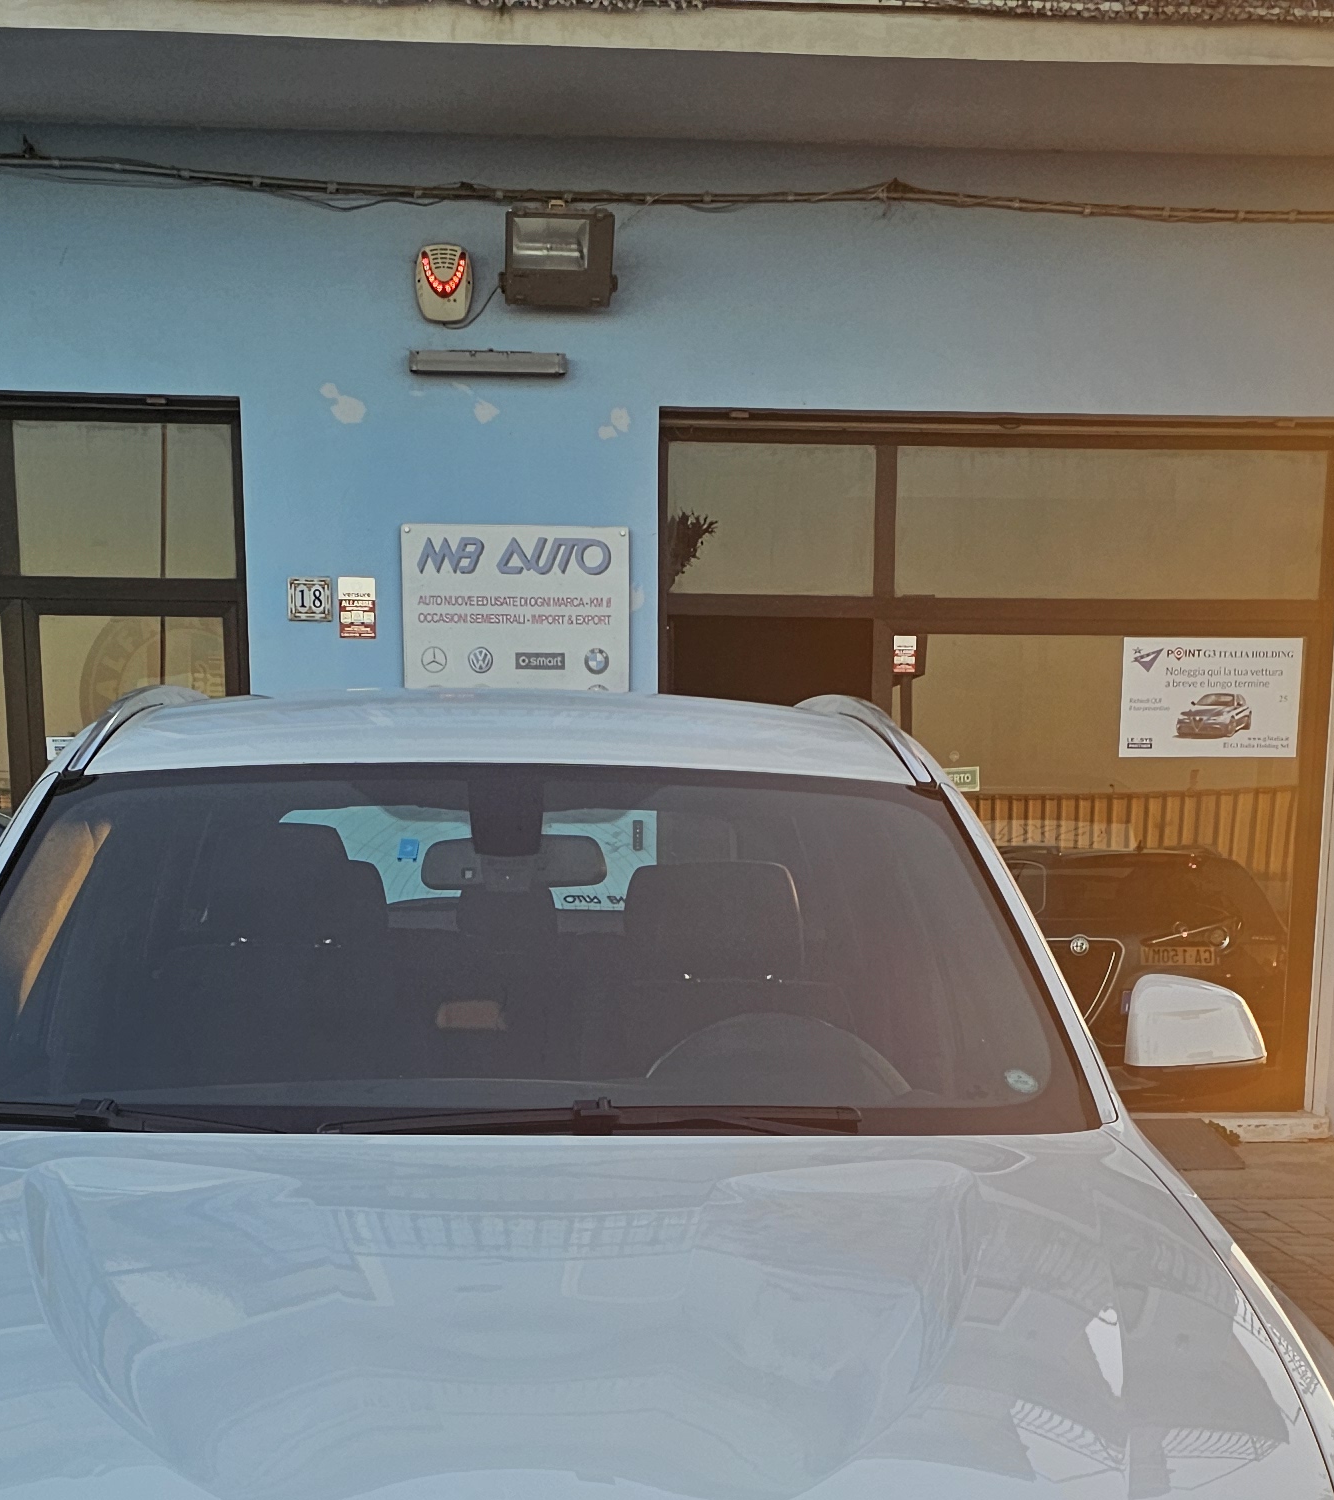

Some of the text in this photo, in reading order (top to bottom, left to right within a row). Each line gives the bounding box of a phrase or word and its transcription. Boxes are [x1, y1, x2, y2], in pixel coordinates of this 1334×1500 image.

[417, 537, 612, 576] MB AUTO
[299, 588, 323, 609] 18
[417, 595, 443, 606] AUTO
[444, 595, 475, 606] NUOVE
[476, 595, 488, 607] ED
[490, 596, 518, 607] USATE
[520, 596, 528, 607] DI
[529, 596, 551, 607] OGNI
[552, 596, 584, 608] MARCA
[589, 597, 603, 608] KM
[418, 612, 467, 624] OCCASIONI
[469, 613, 526, 624] SEMESTRALI
[531, 614, 565, 625] IMPORT
[567, 614, 574, 625] &
[575, 615, 612, 625] EXPORT
[1166, 647, 1294, 661] POINT G3 ITALIA HOLDING
[530, 656, 563, 667] smart
[1165, 667, 1284, 678] Noleggia qui la tua vettura
[1172, 679, 1198, 688] breve
[1207, 679, 1233, 689] lungo
[1234, 679, 1270, 688] termine
